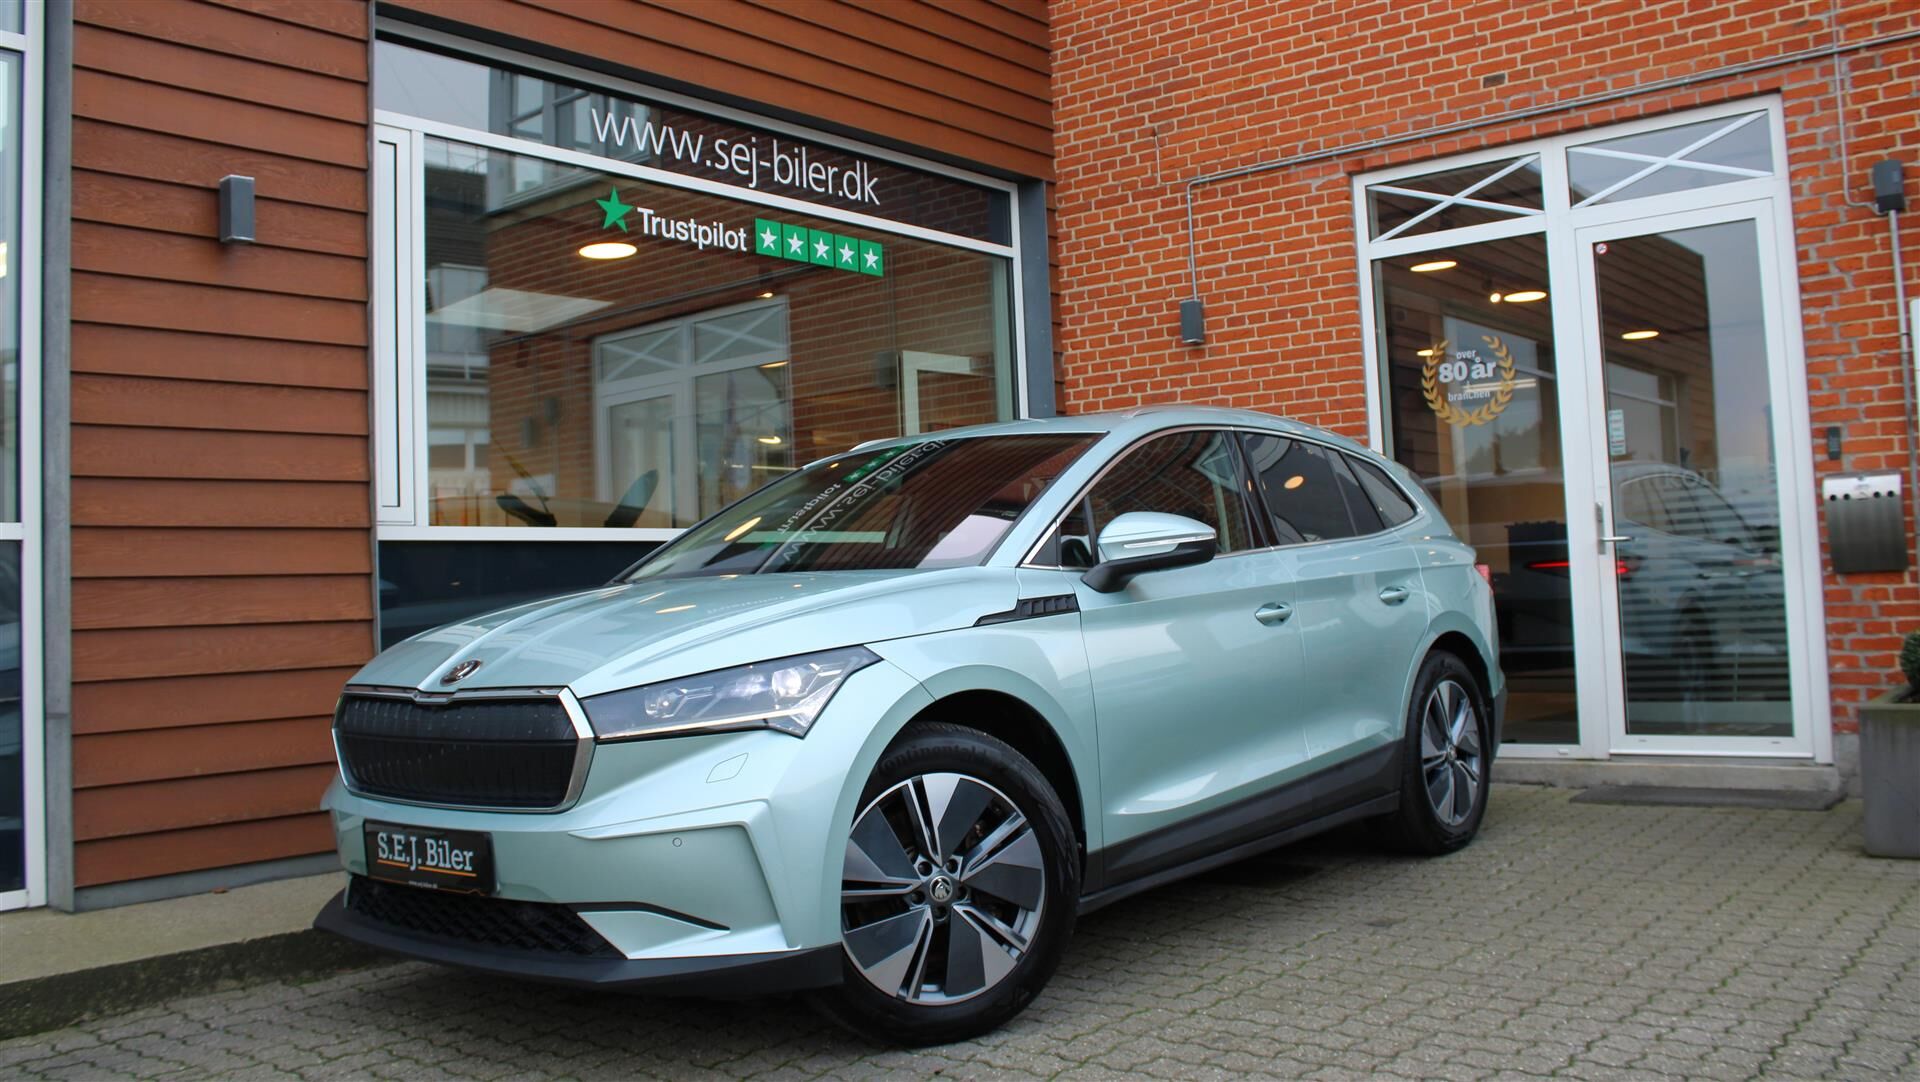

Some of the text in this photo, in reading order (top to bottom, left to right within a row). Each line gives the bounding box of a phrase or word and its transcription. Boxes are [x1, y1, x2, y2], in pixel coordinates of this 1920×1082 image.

[591, 107, 881, 206] www.sej-biler.dk
[637, 207, 747, 251] Trustpilot
[1439, 356, 1497, 383] 80 år
[1456, 349, 1477, 360] over
[377, 832, 474, 872] S.E.J. Biler
